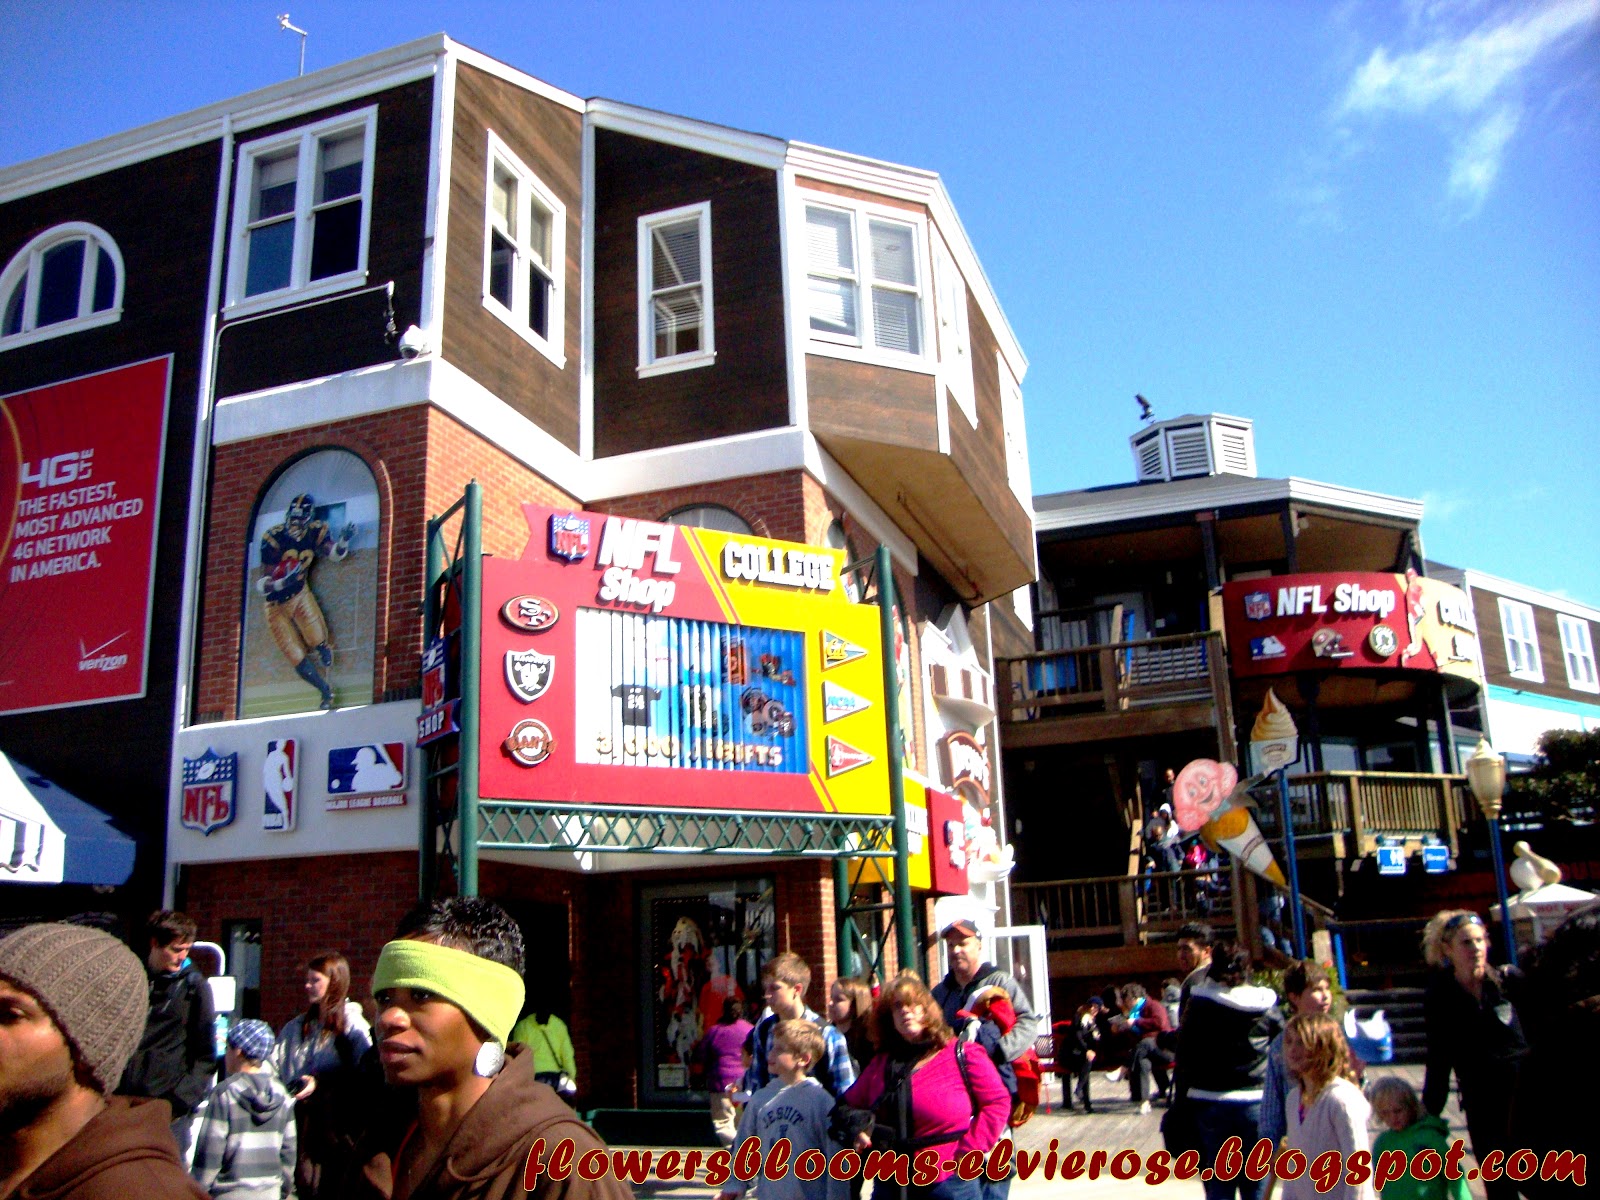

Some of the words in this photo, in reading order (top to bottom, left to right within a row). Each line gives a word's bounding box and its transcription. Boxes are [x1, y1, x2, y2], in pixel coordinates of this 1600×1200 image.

[20, 451, 79, 488] 4G
[19, 496, 47, 517] THE
[49, 481, 117, 508] FASTEST,
[15, 515, 59, 539] MOST
[60, 498, 144, 530] ADVANCED
[13, 541, 34, 560] 4G
[35, 526, 112, 556] NETWORK
[597, 516, 681, 574] NFL
[10, 564, 27, 583] IN
[29, 551, 101, 579] AMERICA.
[722, 541, 836, 591] COLLEGE
[600, 567, 676, 613] Shop
[1277, 585, 1327, 616] NFL
[1333, 583, 1395, 618] Shop
[78, 654, 128, 671] verizon
[418, 709, 445, 739] SHOP
[182, 785, 230, 826] NFL
